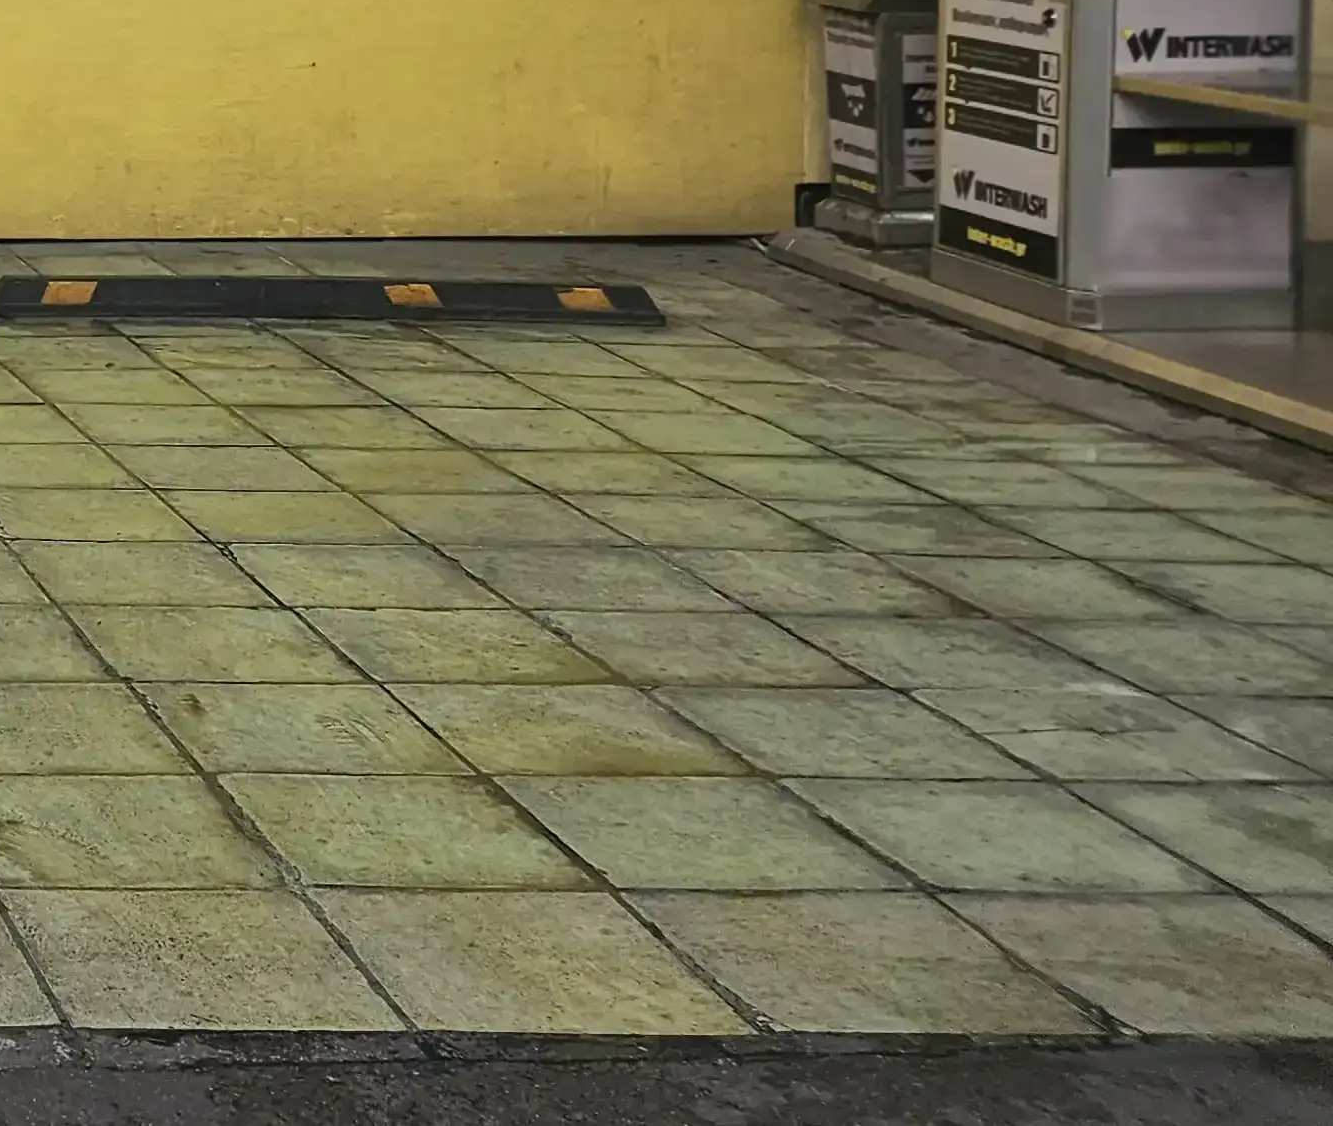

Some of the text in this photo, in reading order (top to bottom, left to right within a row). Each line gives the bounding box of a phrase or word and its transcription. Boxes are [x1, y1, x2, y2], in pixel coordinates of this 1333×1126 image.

[1167, 35, 1294, 58] INTERWASH
[948, 73, 957, 91] 2
[974, 179, 1048, 220] INTERWASH
